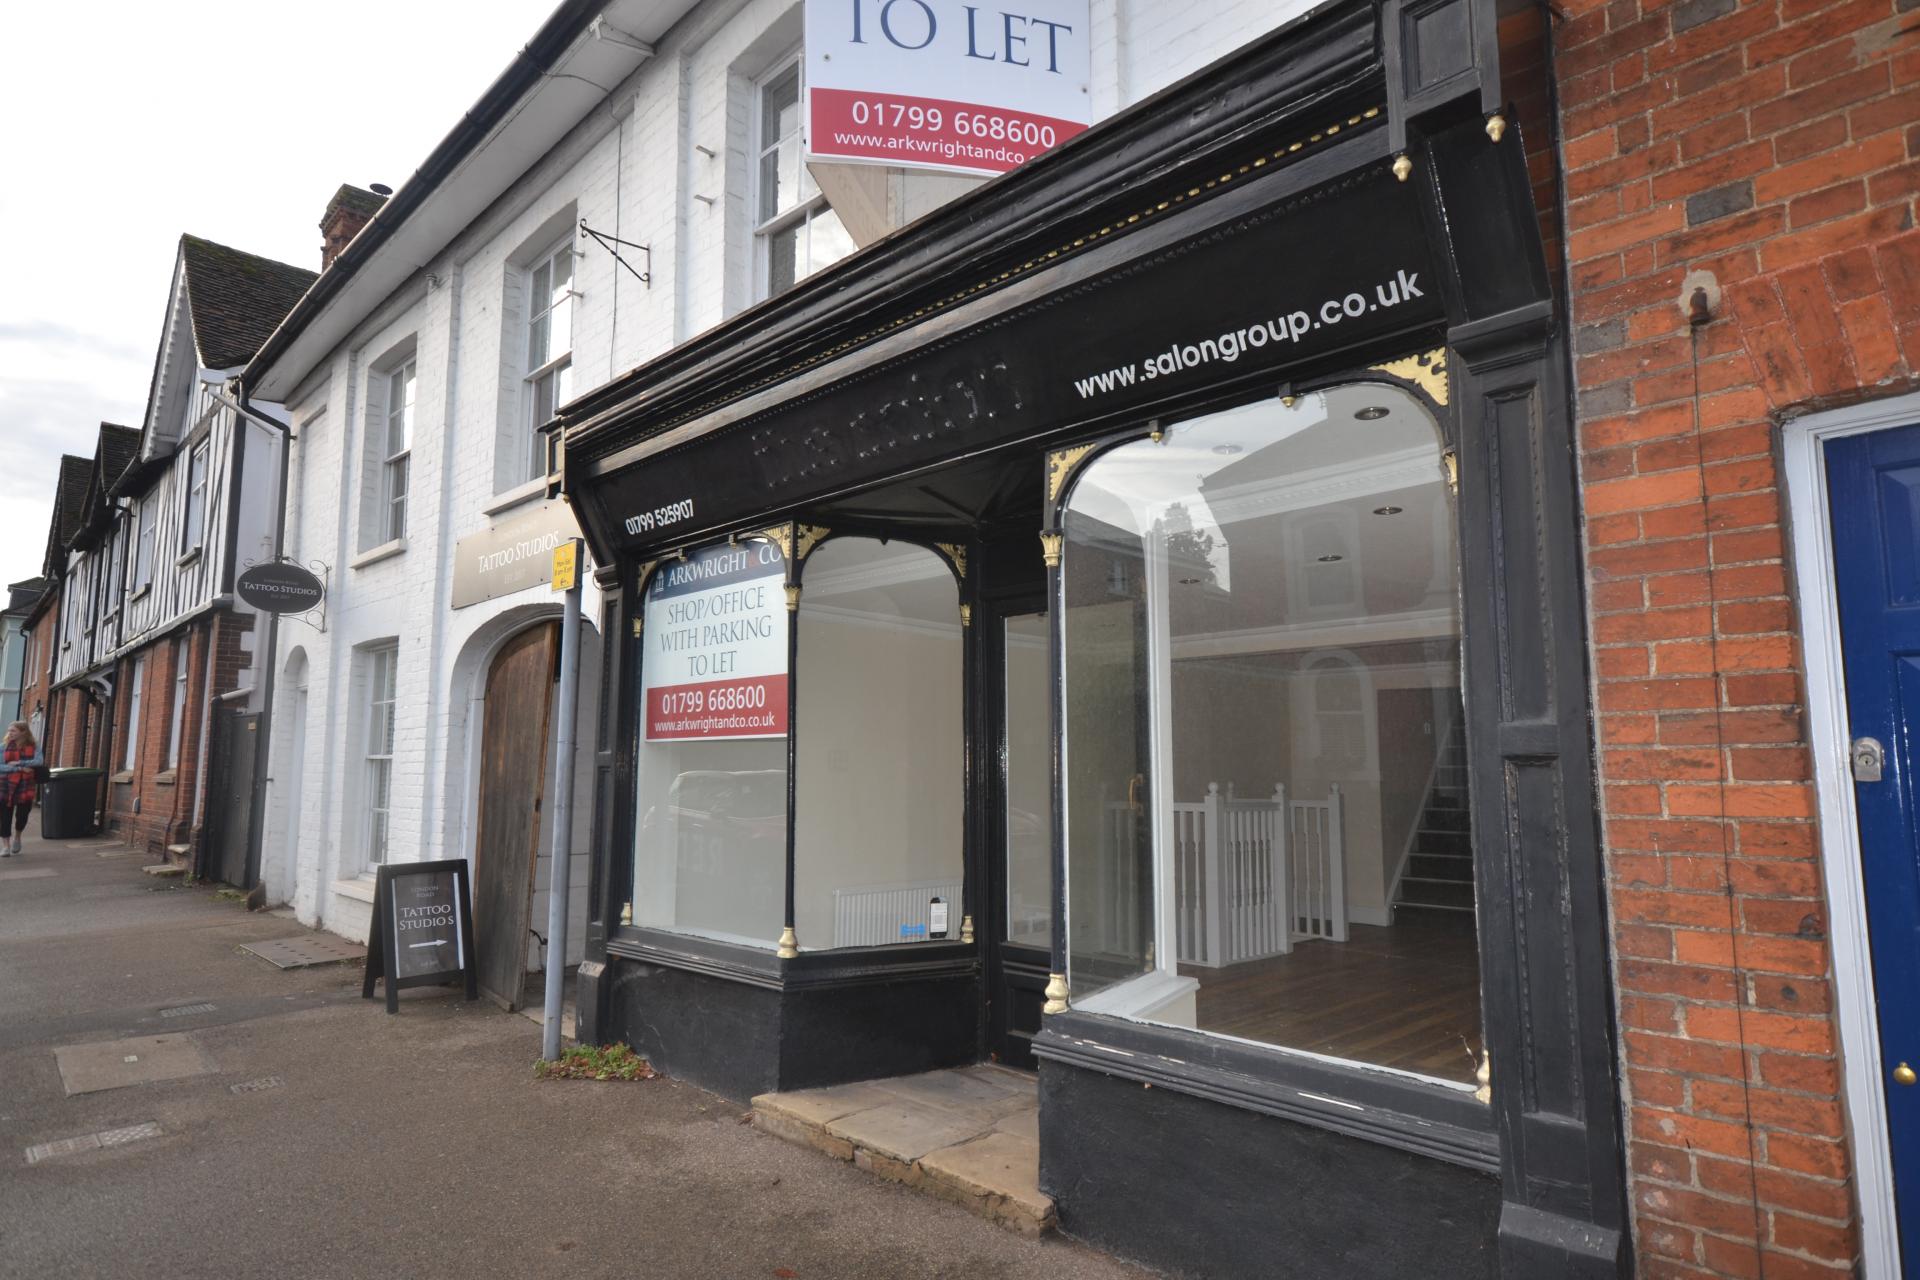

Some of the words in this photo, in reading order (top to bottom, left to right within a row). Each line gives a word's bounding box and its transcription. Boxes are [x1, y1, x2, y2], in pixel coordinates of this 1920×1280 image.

[848, 0, 937, 50] TO
[962, 5, 1073, 74] LET
[852, 100, 943, 132] 01799
[954, 111, 1056, 149] 668600
[834, 131, 1036, 165] www.arkwrightandco
[1074, 269, 1424, 399] www.salongroup.co.uk
[625, 512, 655, 535] 01799
[654, 498, 694, 527] 525907
[478, 547, 515, 574] TATTOO
[515, 531, 559, 561] STUDIOS
[667, 550, 749, 587] ARKWRIGHT
[243, 581, 280, 592] TATTOO
[280, 585, 318, 596] STUDIOS
[667, 586, 765, 625] SHOP/OFFICE
[660, 627, 698, 653] WITH
[703, 615, 772, 647] PARKING
[688, 654, 708, 677] TO
[712, 650, 738, 674] LET
[662, 690, 703, 715] 01799
[708, 684, 766, 712] 668600
[654, 711, 776, 733] www.arkwrightandco.co.uk
[399, 915, 454, 931] STUDIOS
[401, 904, 451, 919] TATTOO
